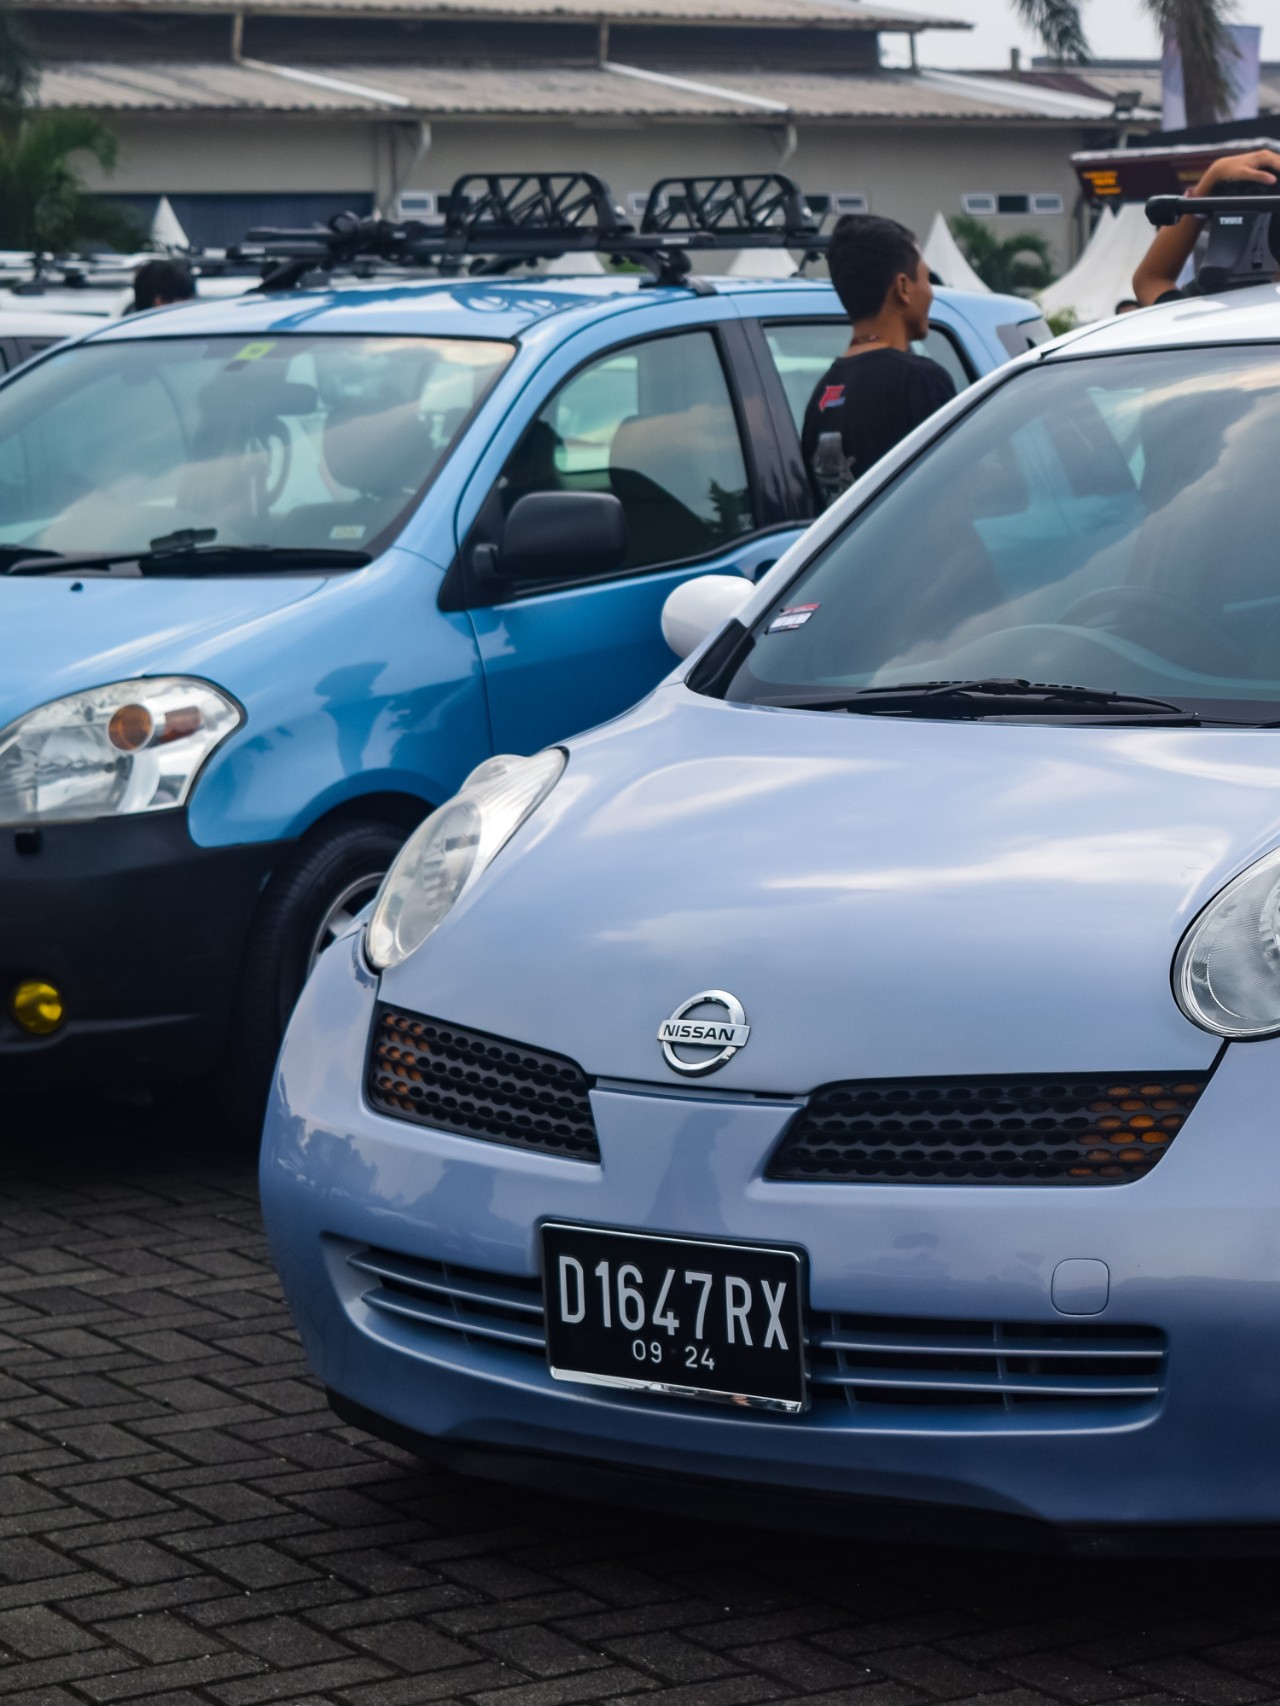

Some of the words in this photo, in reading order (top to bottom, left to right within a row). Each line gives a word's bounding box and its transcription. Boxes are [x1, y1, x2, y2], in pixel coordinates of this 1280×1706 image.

[663, 1024, 735, 1042] NISSAN
[632, 1339, 662, 1364] 09
[685, 1345, 715, 1370] 24
